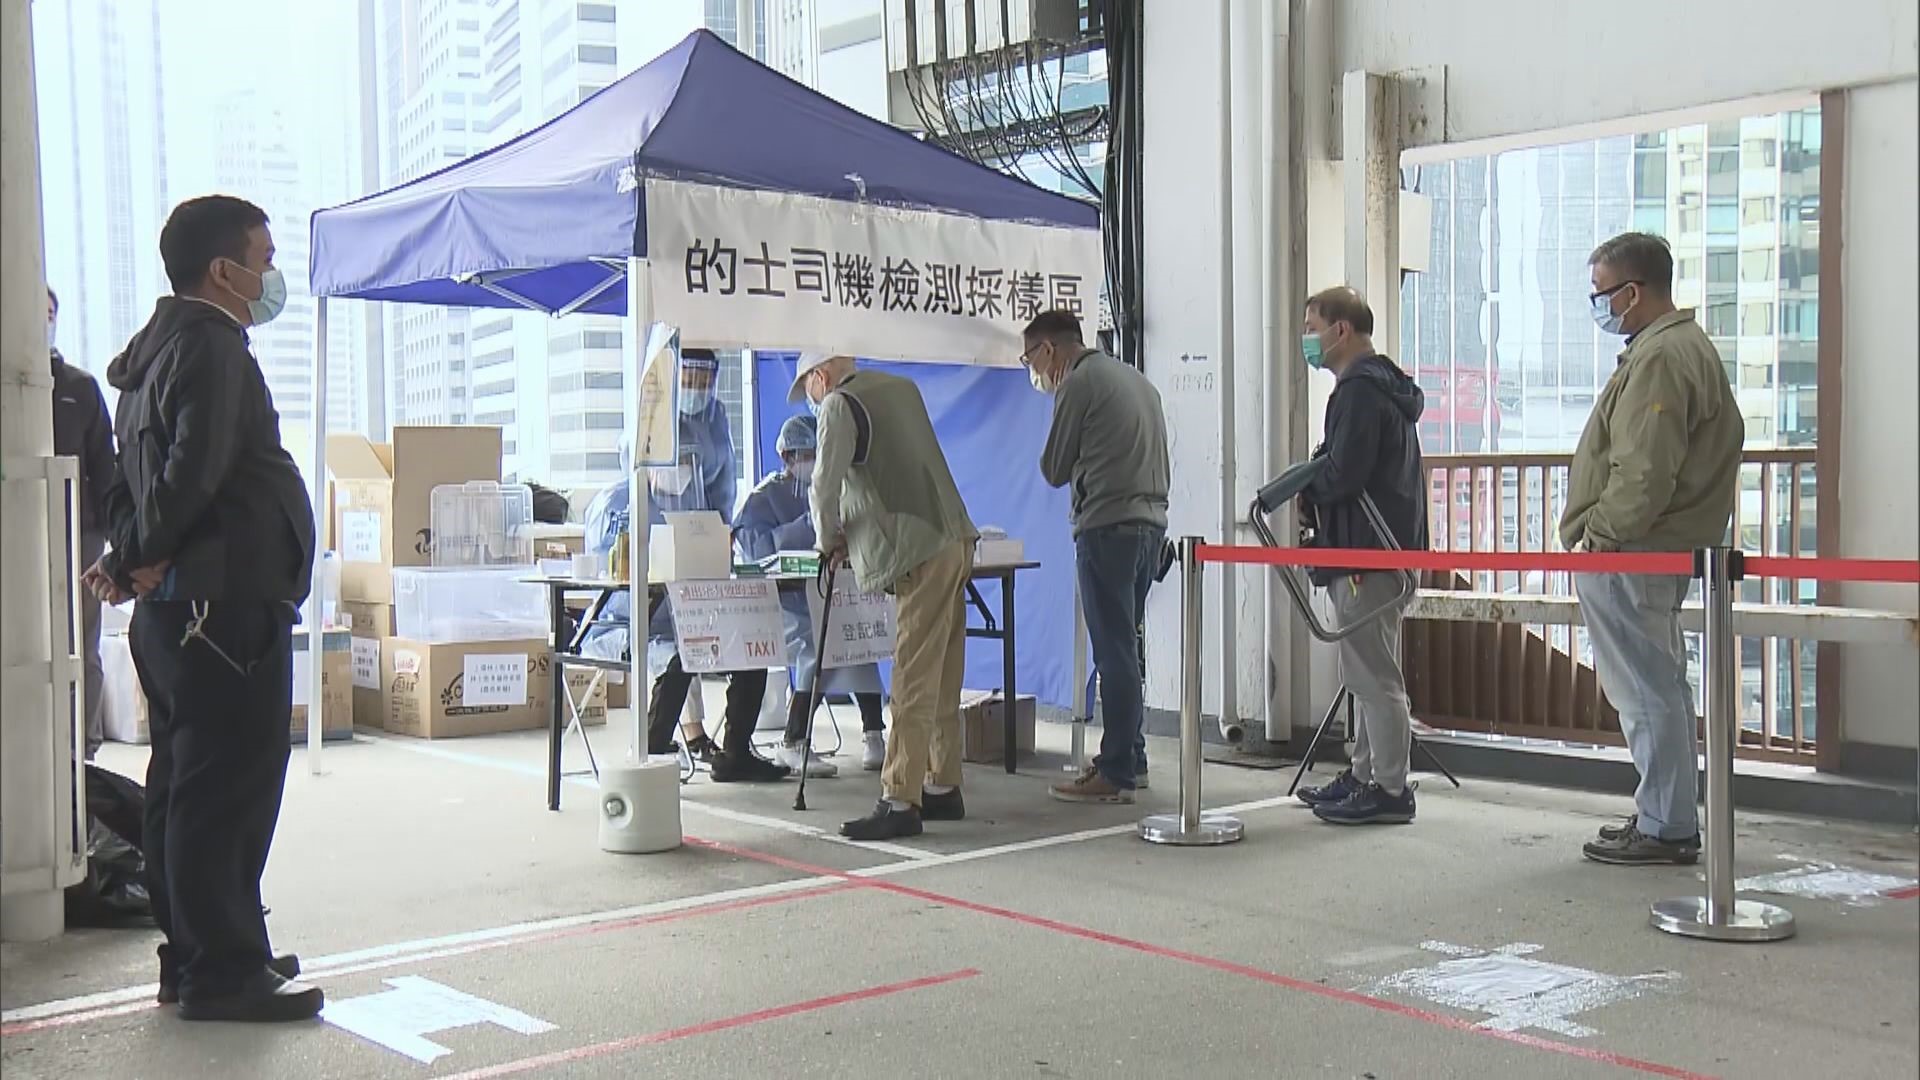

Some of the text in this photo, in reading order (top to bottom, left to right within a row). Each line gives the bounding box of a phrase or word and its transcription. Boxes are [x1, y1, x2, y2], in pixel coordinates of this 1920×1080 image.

[685, 237, 1085, 322] 的士司機檢測採樣區
[746, 640, 776, 657] TAXI
